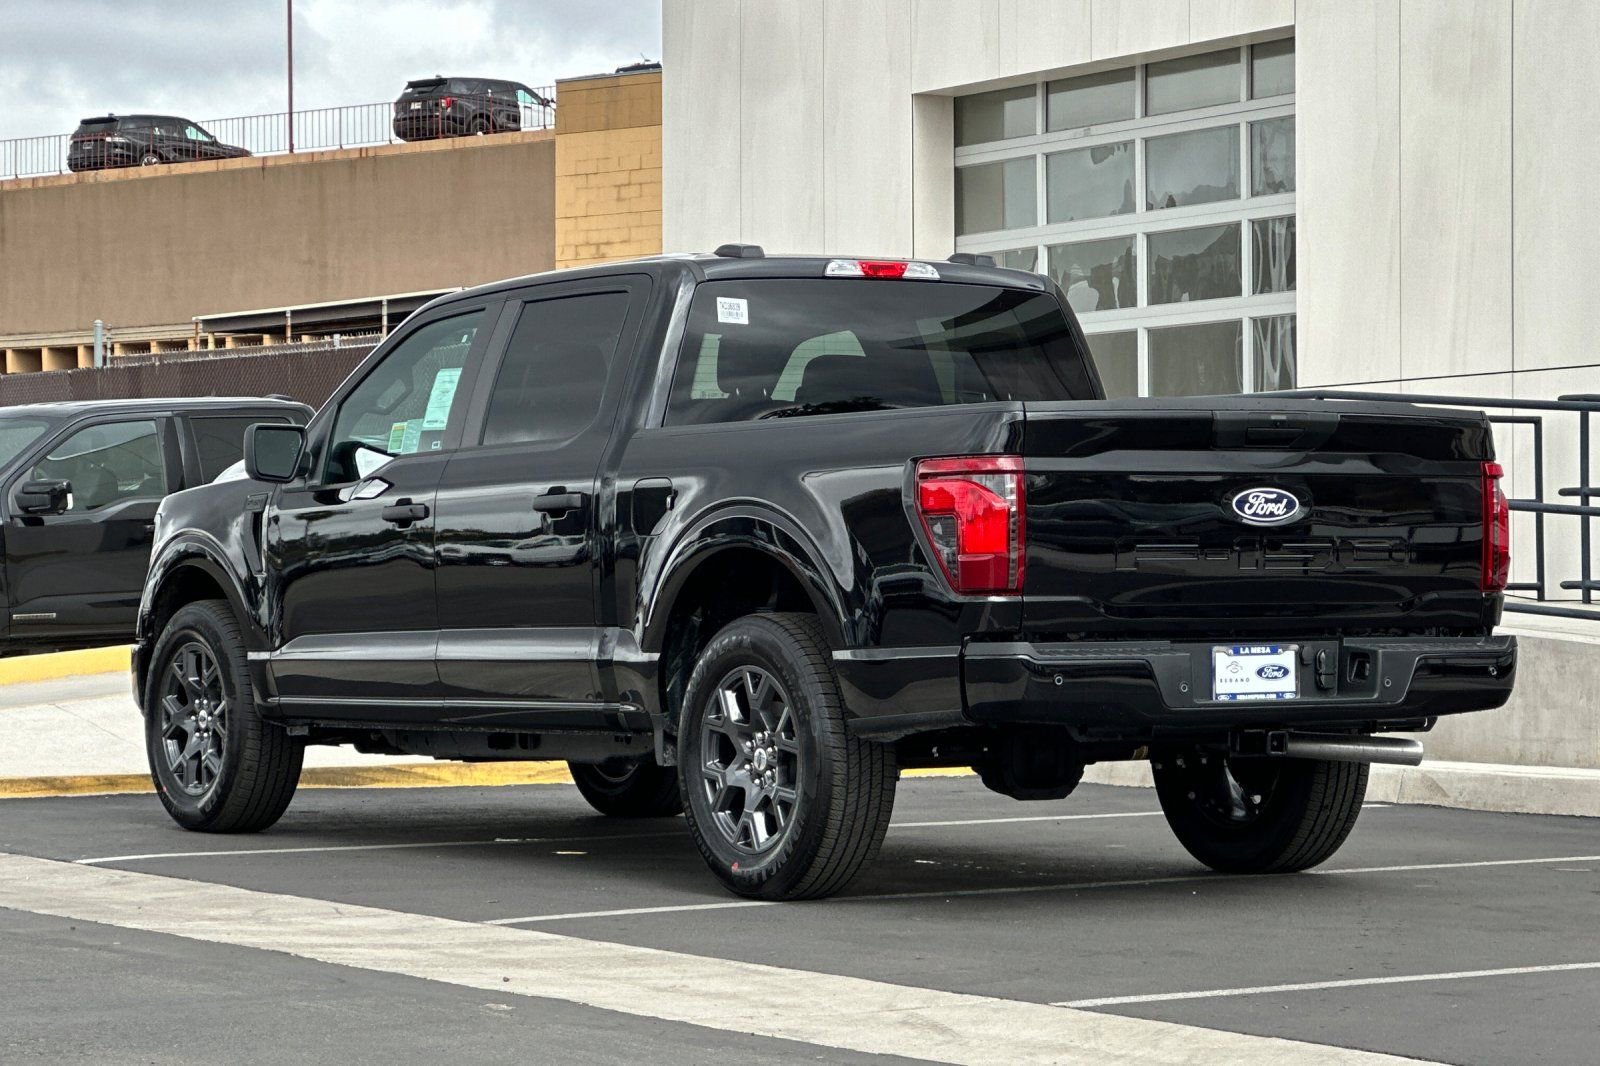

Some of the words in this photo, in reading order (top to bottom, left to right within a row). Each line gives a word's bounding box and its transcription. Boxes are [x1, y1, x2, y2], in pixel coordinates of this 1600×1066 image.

[1243, 491, 1289, 516] Ford
[1115, 536, 1410, 571] F-150
[1250, 646, 1271, 654] MESA
[1261, 665, 1284, 678] Ford
